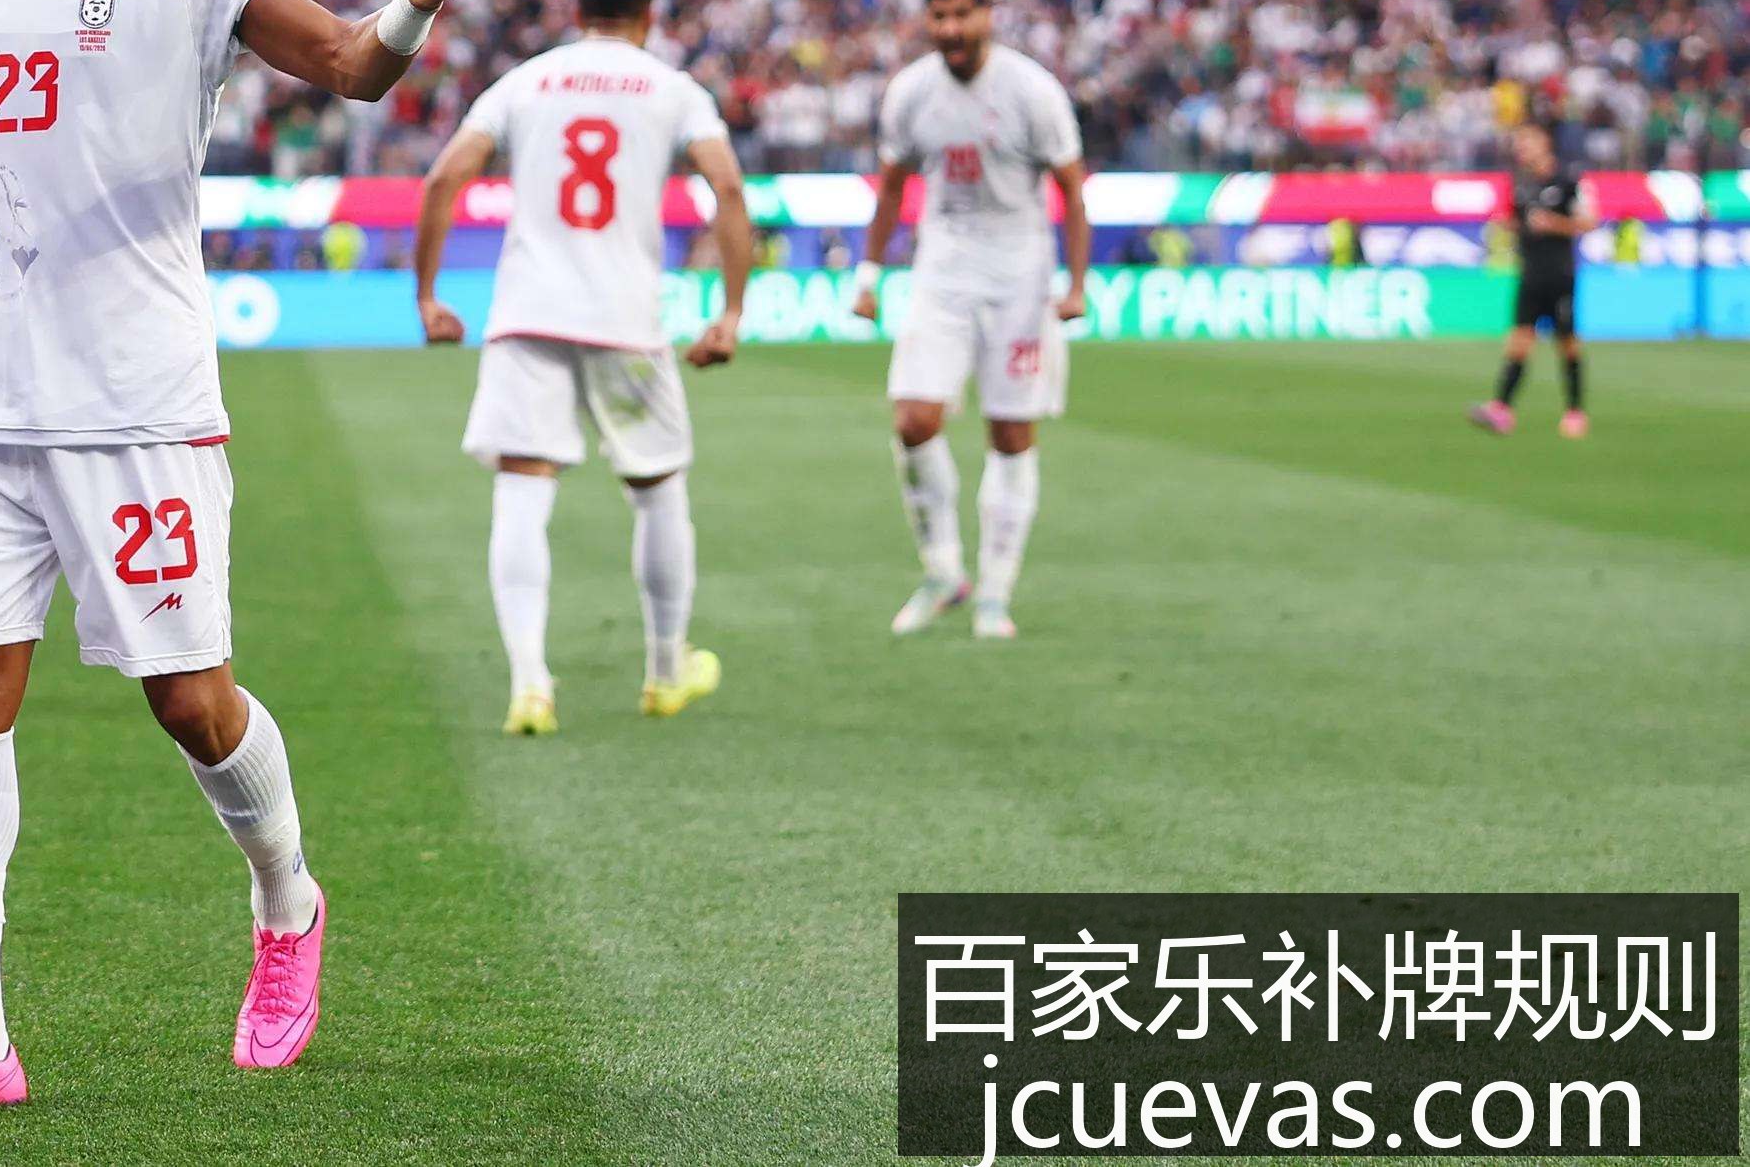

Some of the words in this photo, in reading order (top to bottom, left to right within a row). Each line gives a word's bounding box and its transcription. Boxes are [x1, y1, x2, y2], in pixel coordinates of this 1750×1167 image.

[559, 115, 620, 231] 8
[1139, 268, 1433, 341] PARTNER
[112, 498, 199, 584] 23
